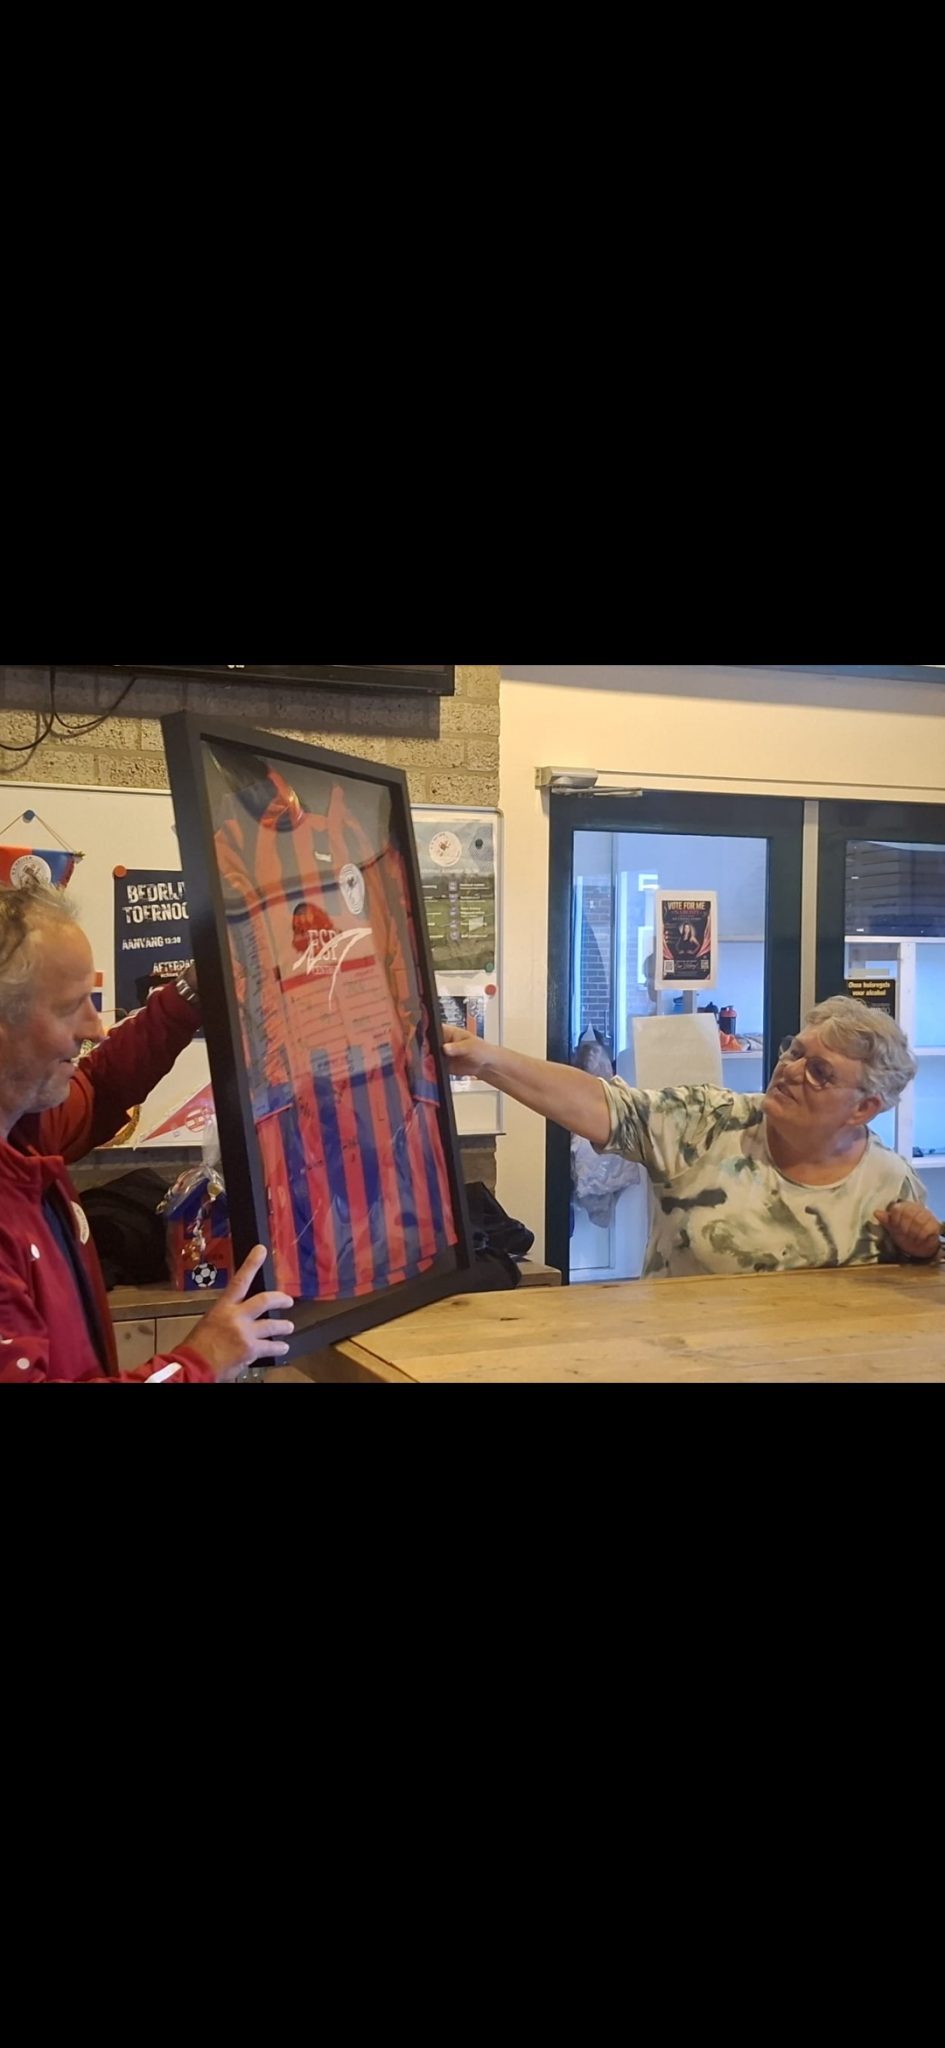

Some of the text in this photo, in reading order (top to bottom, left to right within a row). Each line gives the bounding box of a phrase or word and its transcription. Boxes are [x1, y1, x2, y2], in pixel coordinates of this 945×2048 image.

[667, 901, 705, 910] VOTE FOR ME
[122, 936, 164, 950] AANVANG
